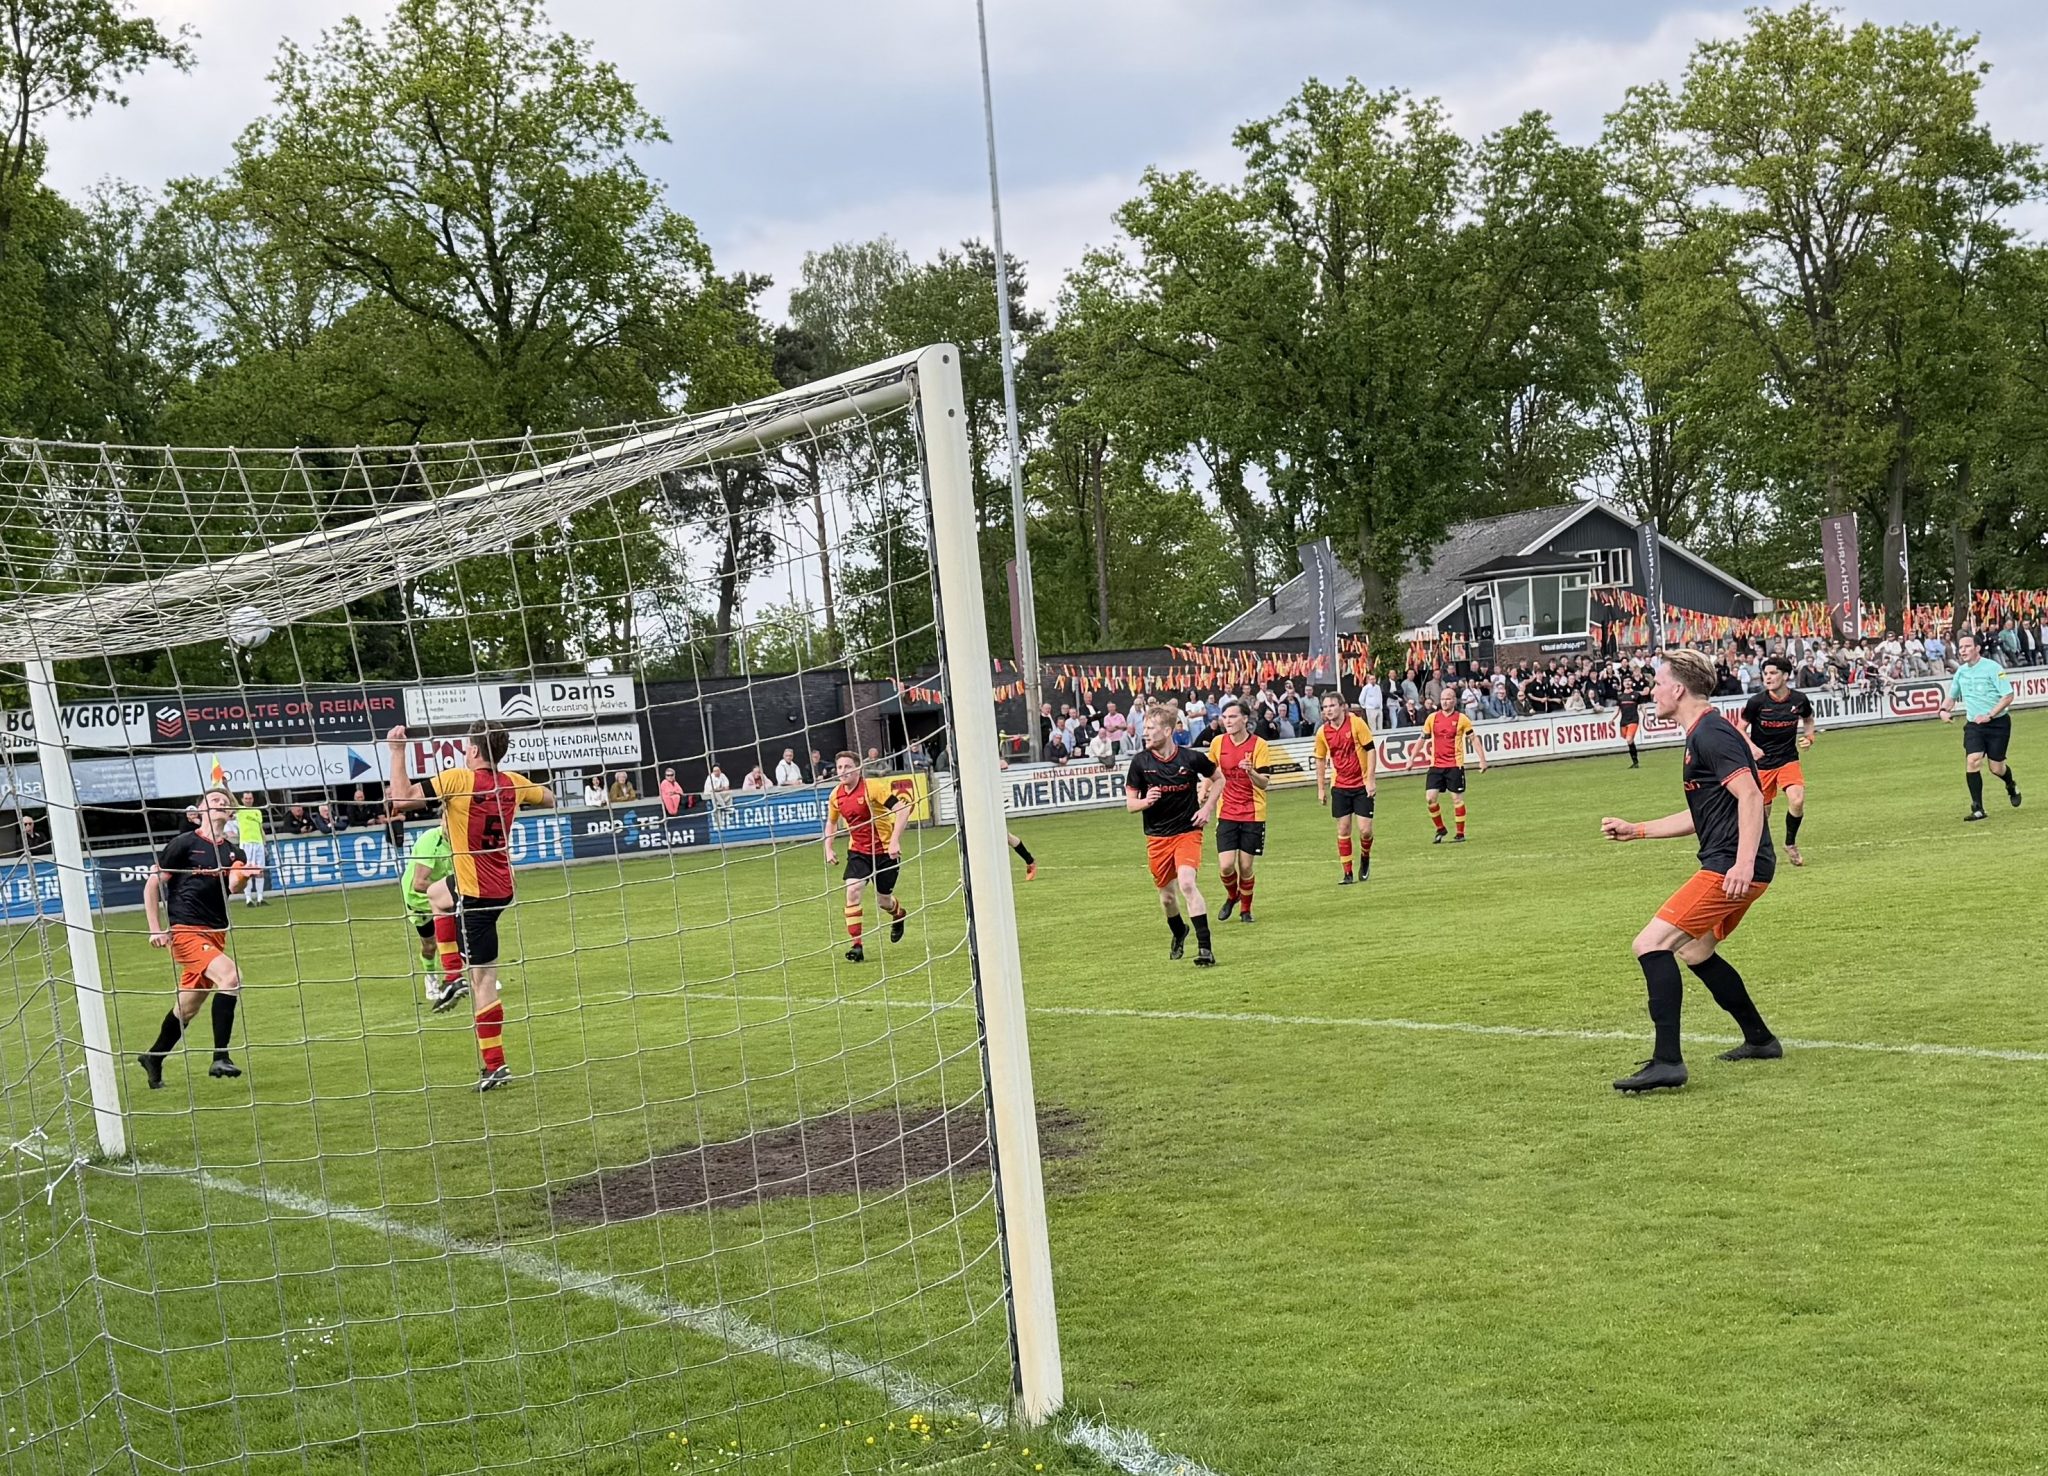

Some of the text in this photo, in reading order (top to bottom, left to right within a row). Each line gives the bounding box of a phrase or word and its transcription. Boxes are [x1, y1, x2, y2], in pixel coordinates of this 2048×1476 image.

[551, 683, 614, 701] Dams
[1895, 684, 1940, 713] RSS
[186, 697, 396, 721] SCHOLTE OP REIMER
[542, 702, 589, 713] Accounting
[600, 701, 628, 709] Advies
[1844, 695, 1879, 715] TIME!
[7, 703, 145, 731] BOWGROEP
[519, 737, 550, 748] OUDE
[1503, 728, 1550, 750] SAFETY
[1557, 722, 1617, 744] SYSTEMS
[538, 745, 638, 760] BOUWMATERIALEN
[220, 759, 344, 782] onnectworks
[779, 801, 818, 824] BEND
[482, 815, 506, 850] 5
[639, 829, 695, 848] BEJAH
[272, 838, 341, 887] WE!
